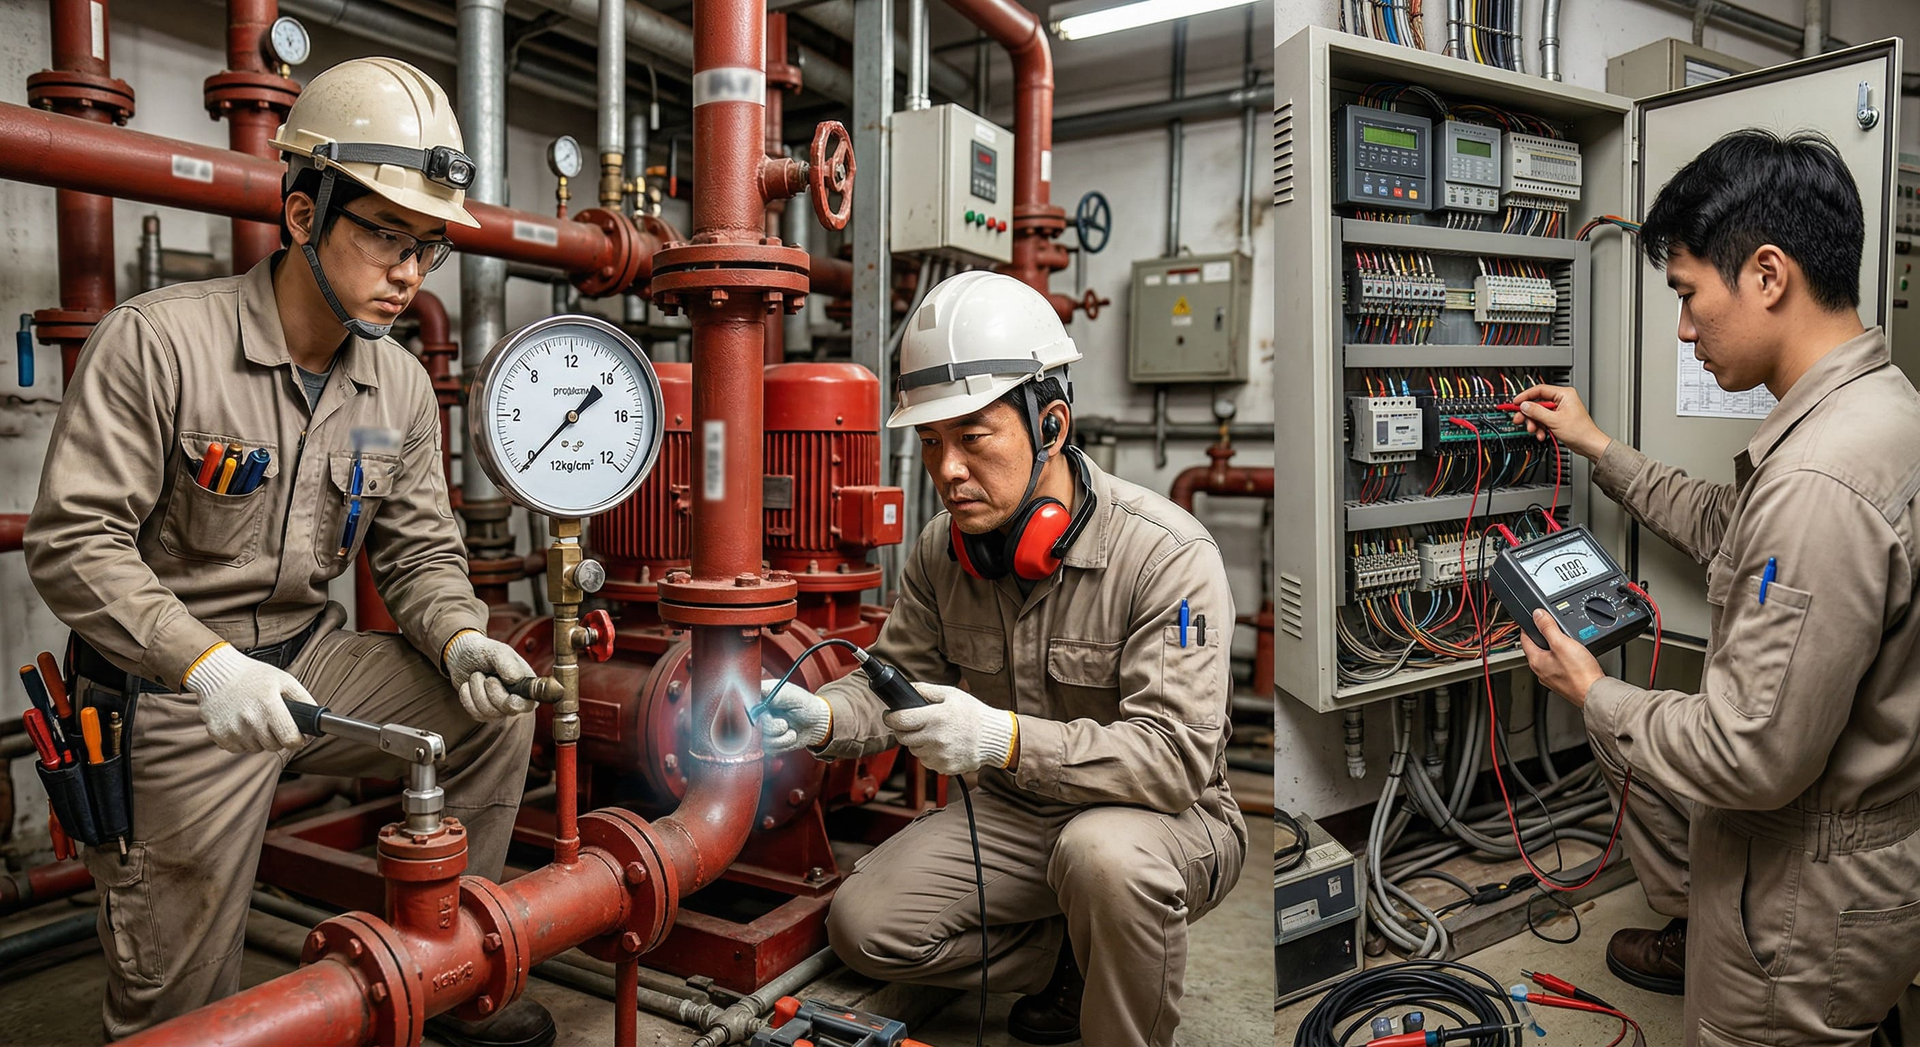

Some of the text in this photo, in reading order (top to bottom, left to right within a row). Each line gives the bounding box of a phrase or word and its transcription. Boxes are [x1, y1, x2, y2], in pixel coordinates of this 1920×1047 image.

[564, 354, 579, 368] 12
[530, 369, 539, 383] 8
[513, 408, 521, 421] 2
[614, 410, 628, 423] 16
[600, 451, 614, 464] 12
